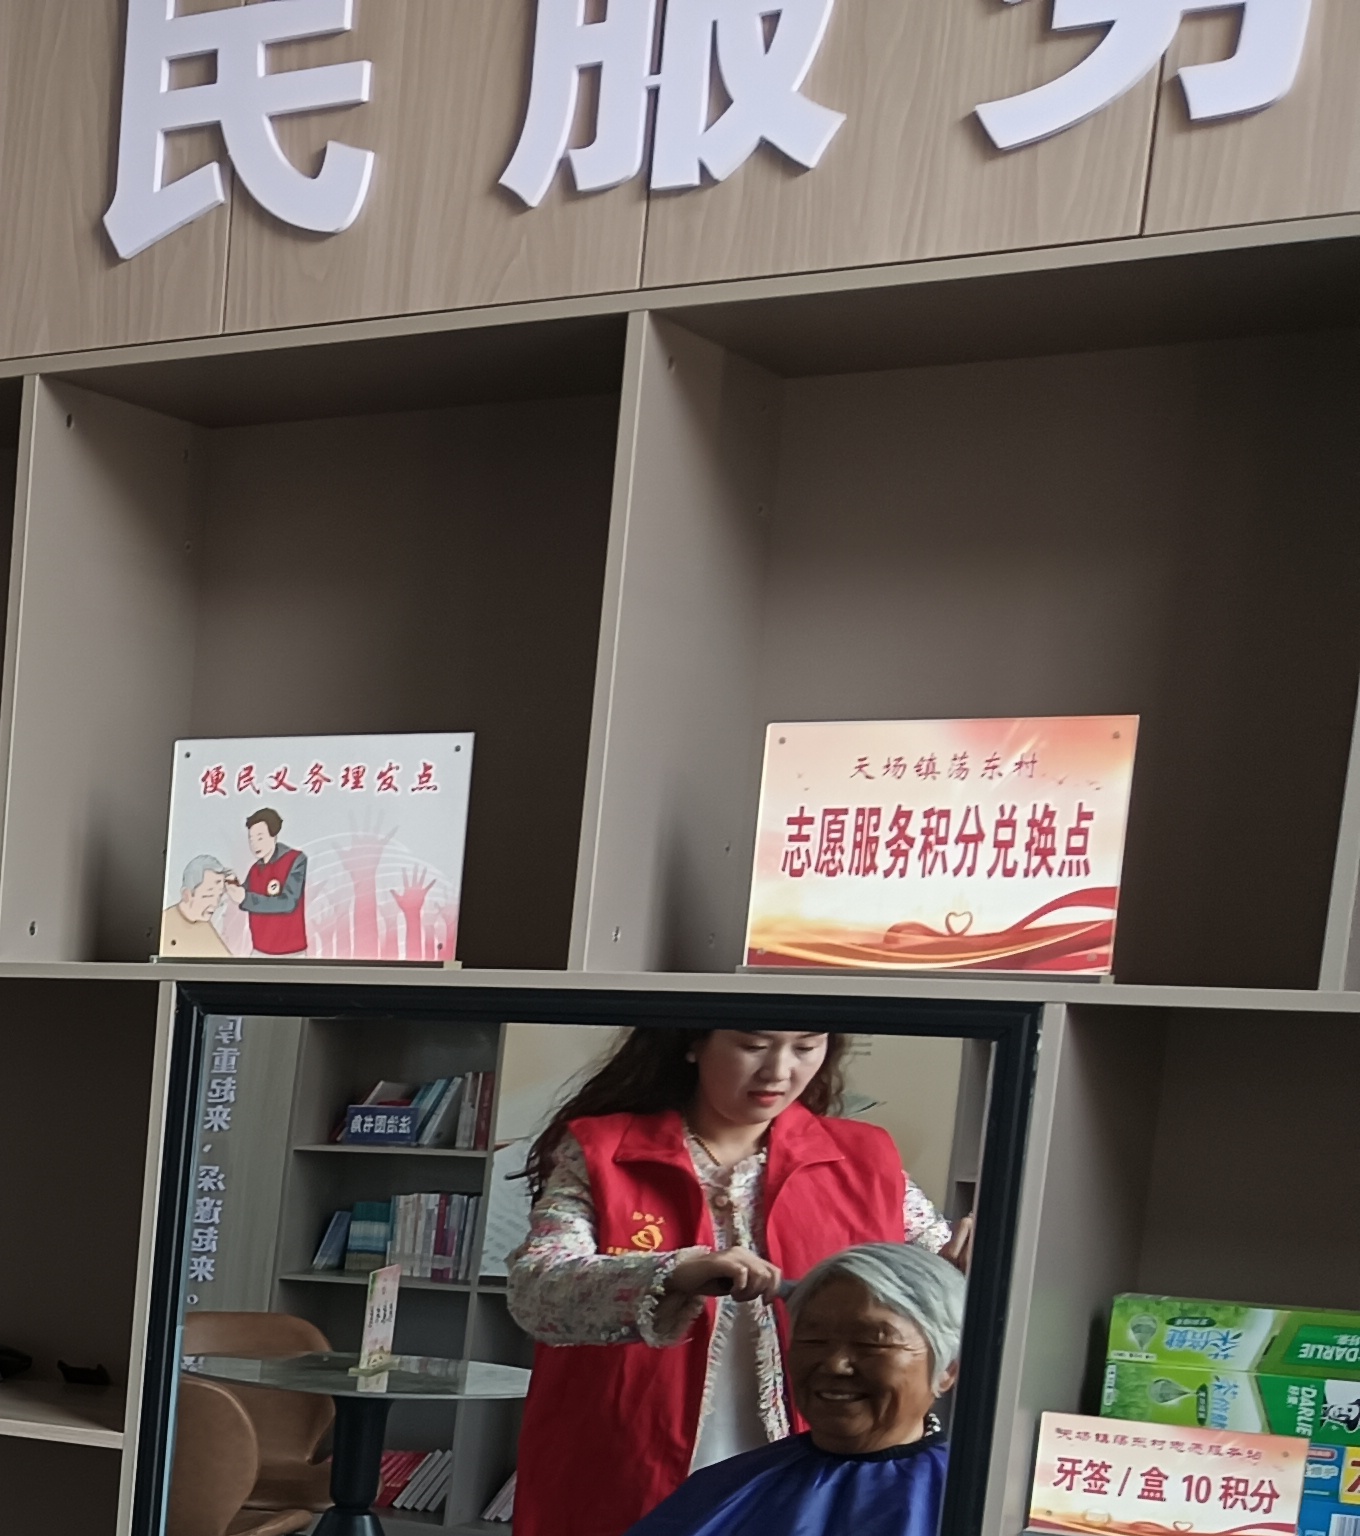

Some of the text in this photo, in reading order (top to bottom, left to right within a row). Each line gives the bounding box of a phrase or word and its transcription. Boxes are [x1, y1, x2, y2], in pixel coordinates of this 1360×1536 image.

[200, 761, 440, 797] 便民义务理发点
[780, 802, 1096, 880] 志愿服务积分兑换点
[1297, 1343, 1360, 1363] DARLIE
[1295, 1386, 1318, 1437] DARLIE
[1182, 1474, 1212, 1504] 10
[1218, 1476, 1281, 1514] 积分
